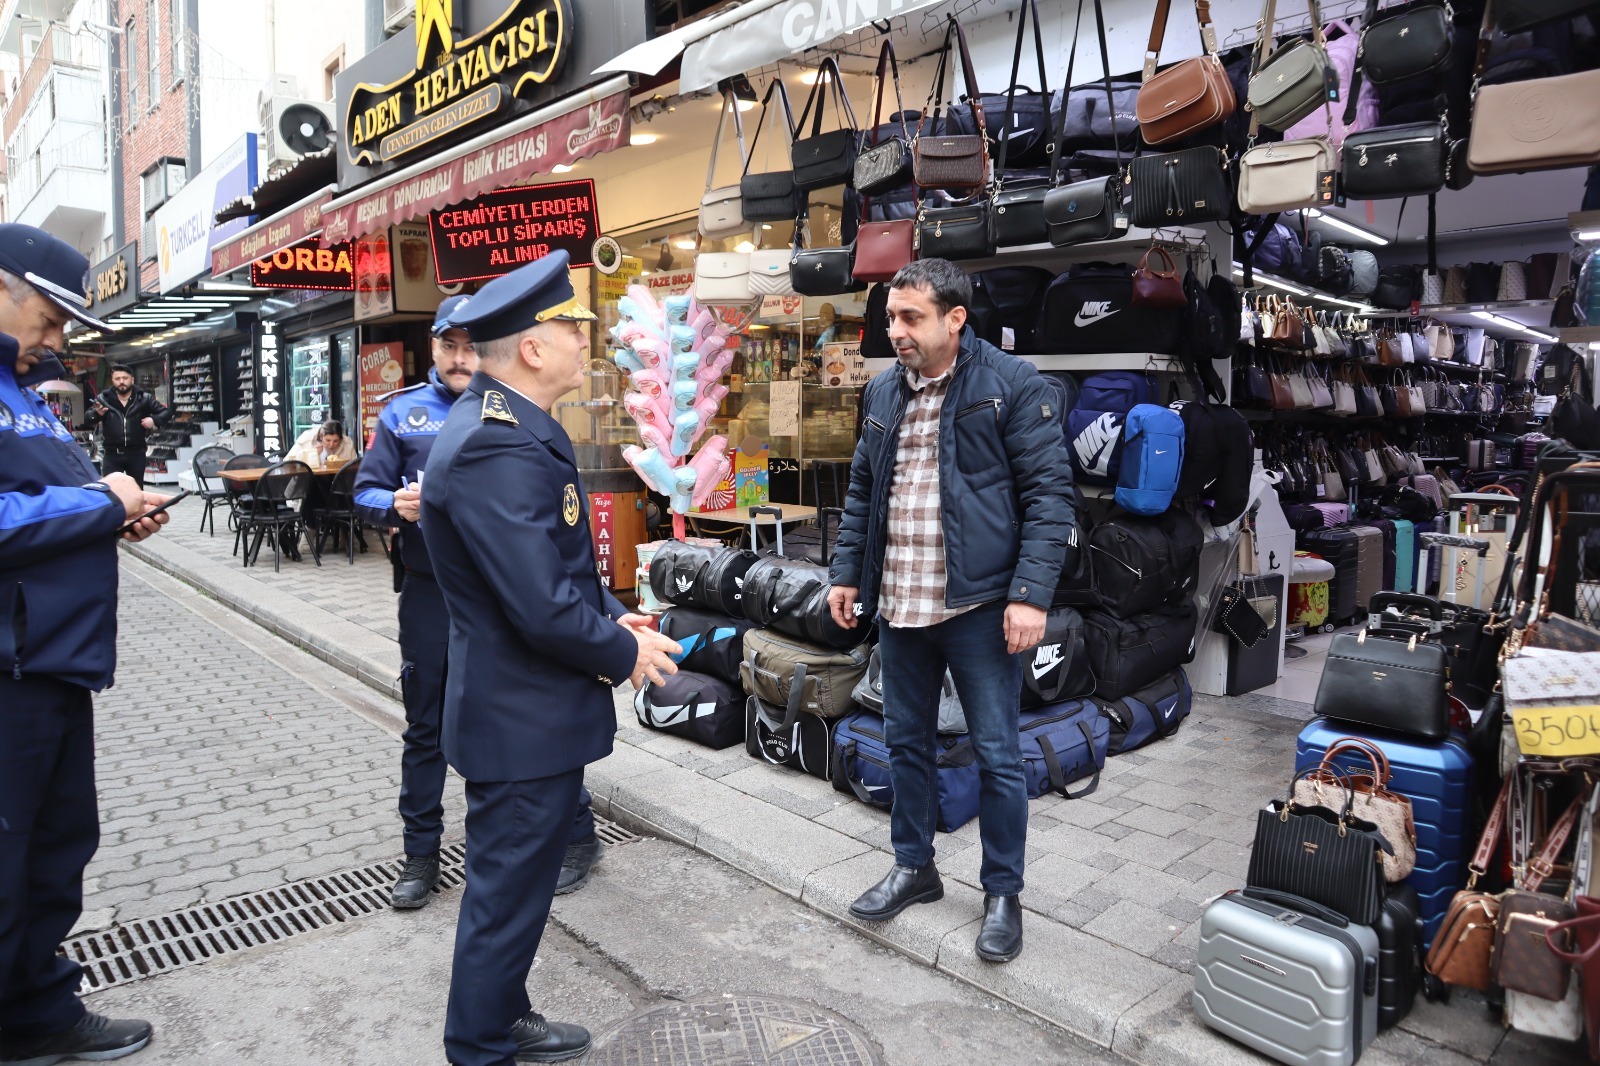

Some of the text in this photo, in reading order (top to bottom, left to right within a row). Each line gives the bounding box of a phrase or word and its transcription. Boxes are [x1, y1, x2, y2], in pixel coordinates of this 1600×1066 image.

[352, 9, 549, 147] ADEN HELVACISI
[386, 93, 492, 154] CENNETTEN GELEN LEZZET
[357, 196, 388, 225] MEŞHUR
[394, 169, 453, 210] DONDURMALI
[463, 150, 494, 184] İRMİK
[496, 131, 548, 172] HELVASI
[438, 196, 589, 229] CEMİYETLERDEN
[169, 210, 206, 257] TURKCELL
[399, 228, 428, 238] YAPRAK
[446, 214, 587, 249] TOPLU SİPARİŞ
[253, 247, 353, 275] ÇORBA
[491, 243, 550, 265] ALINIR
[97, 255, 128, 302] SHOE'S
[647, 276, 670, 289] TAZE
[672, 273, 695, 286] SICA
[1080, 301, 1112, 316] NIKE
[362, 346, 391, 376] ÇORBA
[1073, 411, 1122, 467] NIKE
[769, 460, 799, 474] حلاوة
[594, 497, 613, 508] Taze
[598, 511, 611, 587] TAHİN
[1035, 643, 1062, 666] NIKE
